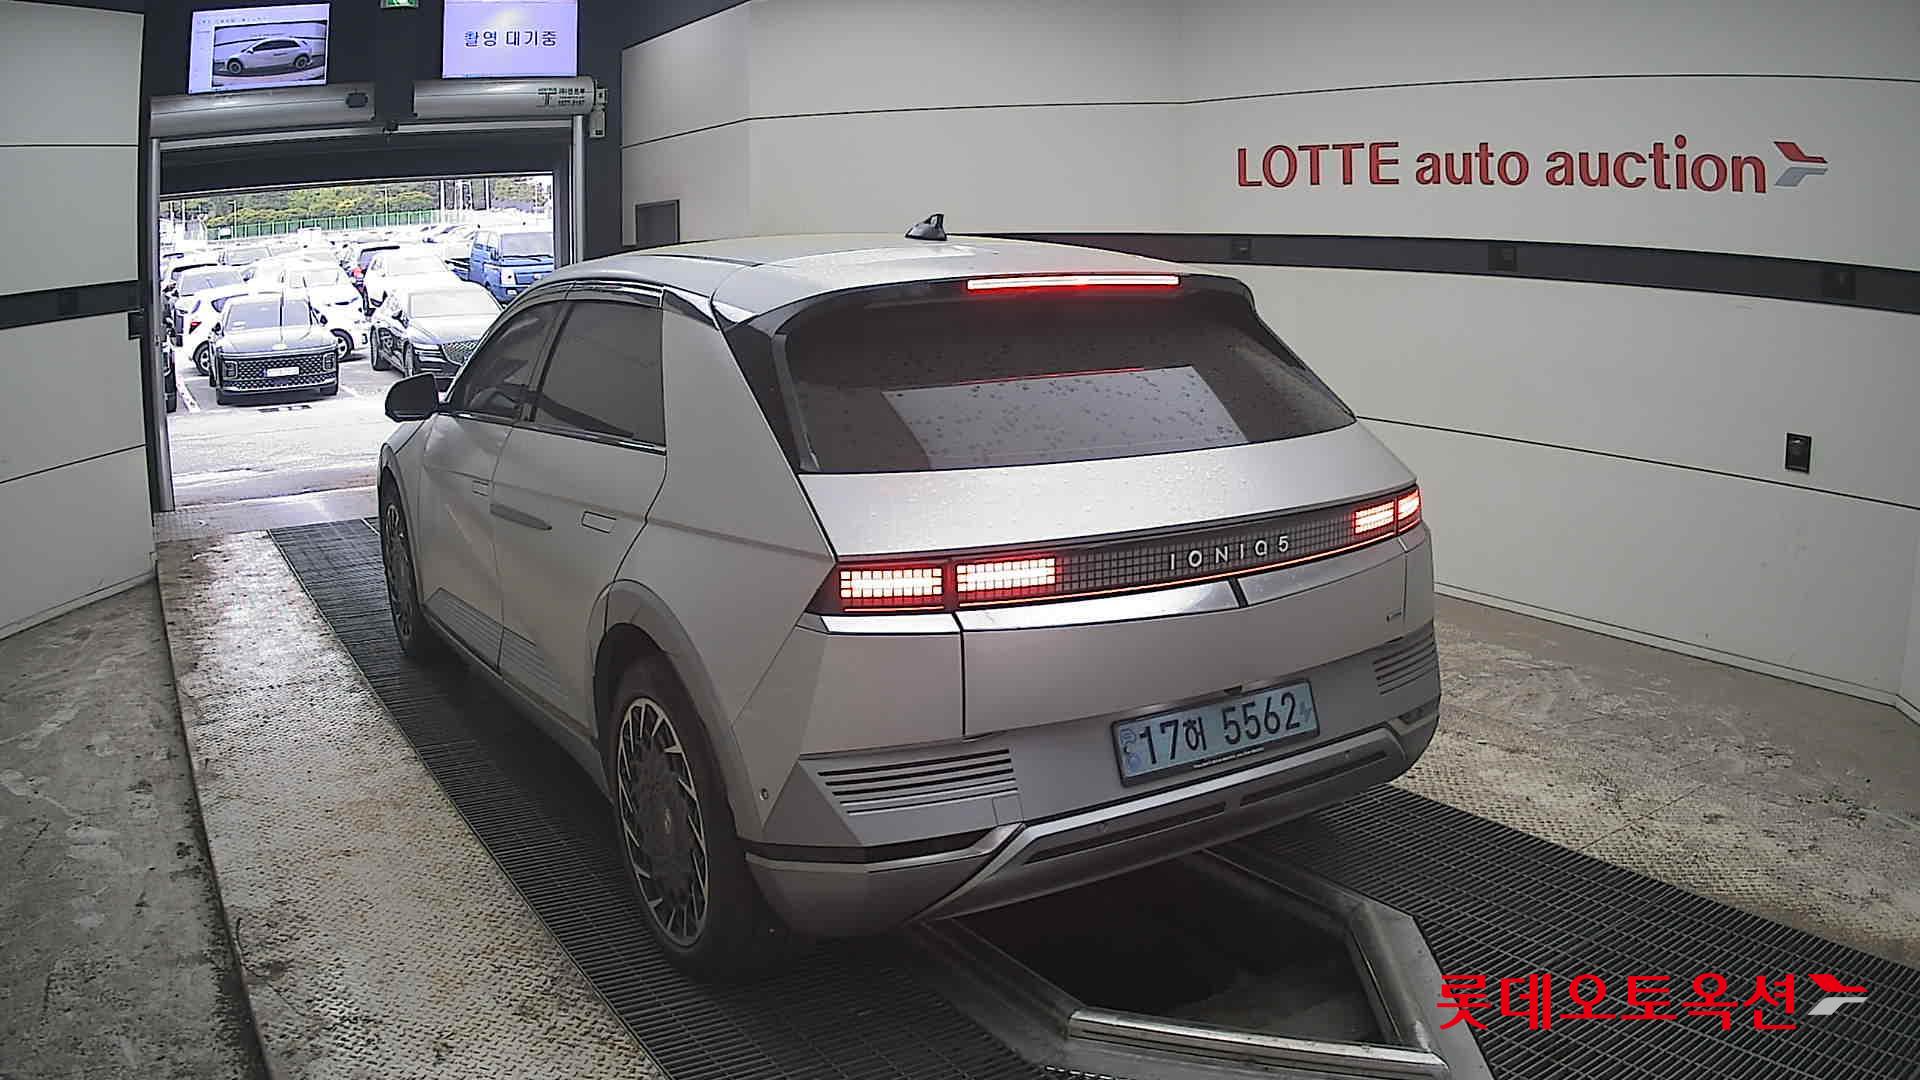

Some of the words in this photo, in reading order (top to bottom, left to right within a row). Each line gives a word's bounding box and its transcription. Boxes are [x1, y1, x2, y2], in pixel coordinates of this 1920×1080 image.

[505, 29, 558, 47] 대기중
[1238, 142, 1399, 188] LOTTE
[1415, 142, 1530, 187] auto
[1546, 135, 1767, 194] auction
[1139, 716, 1207, 764] 17허
[1221, 691, 1301, 745] 5562
